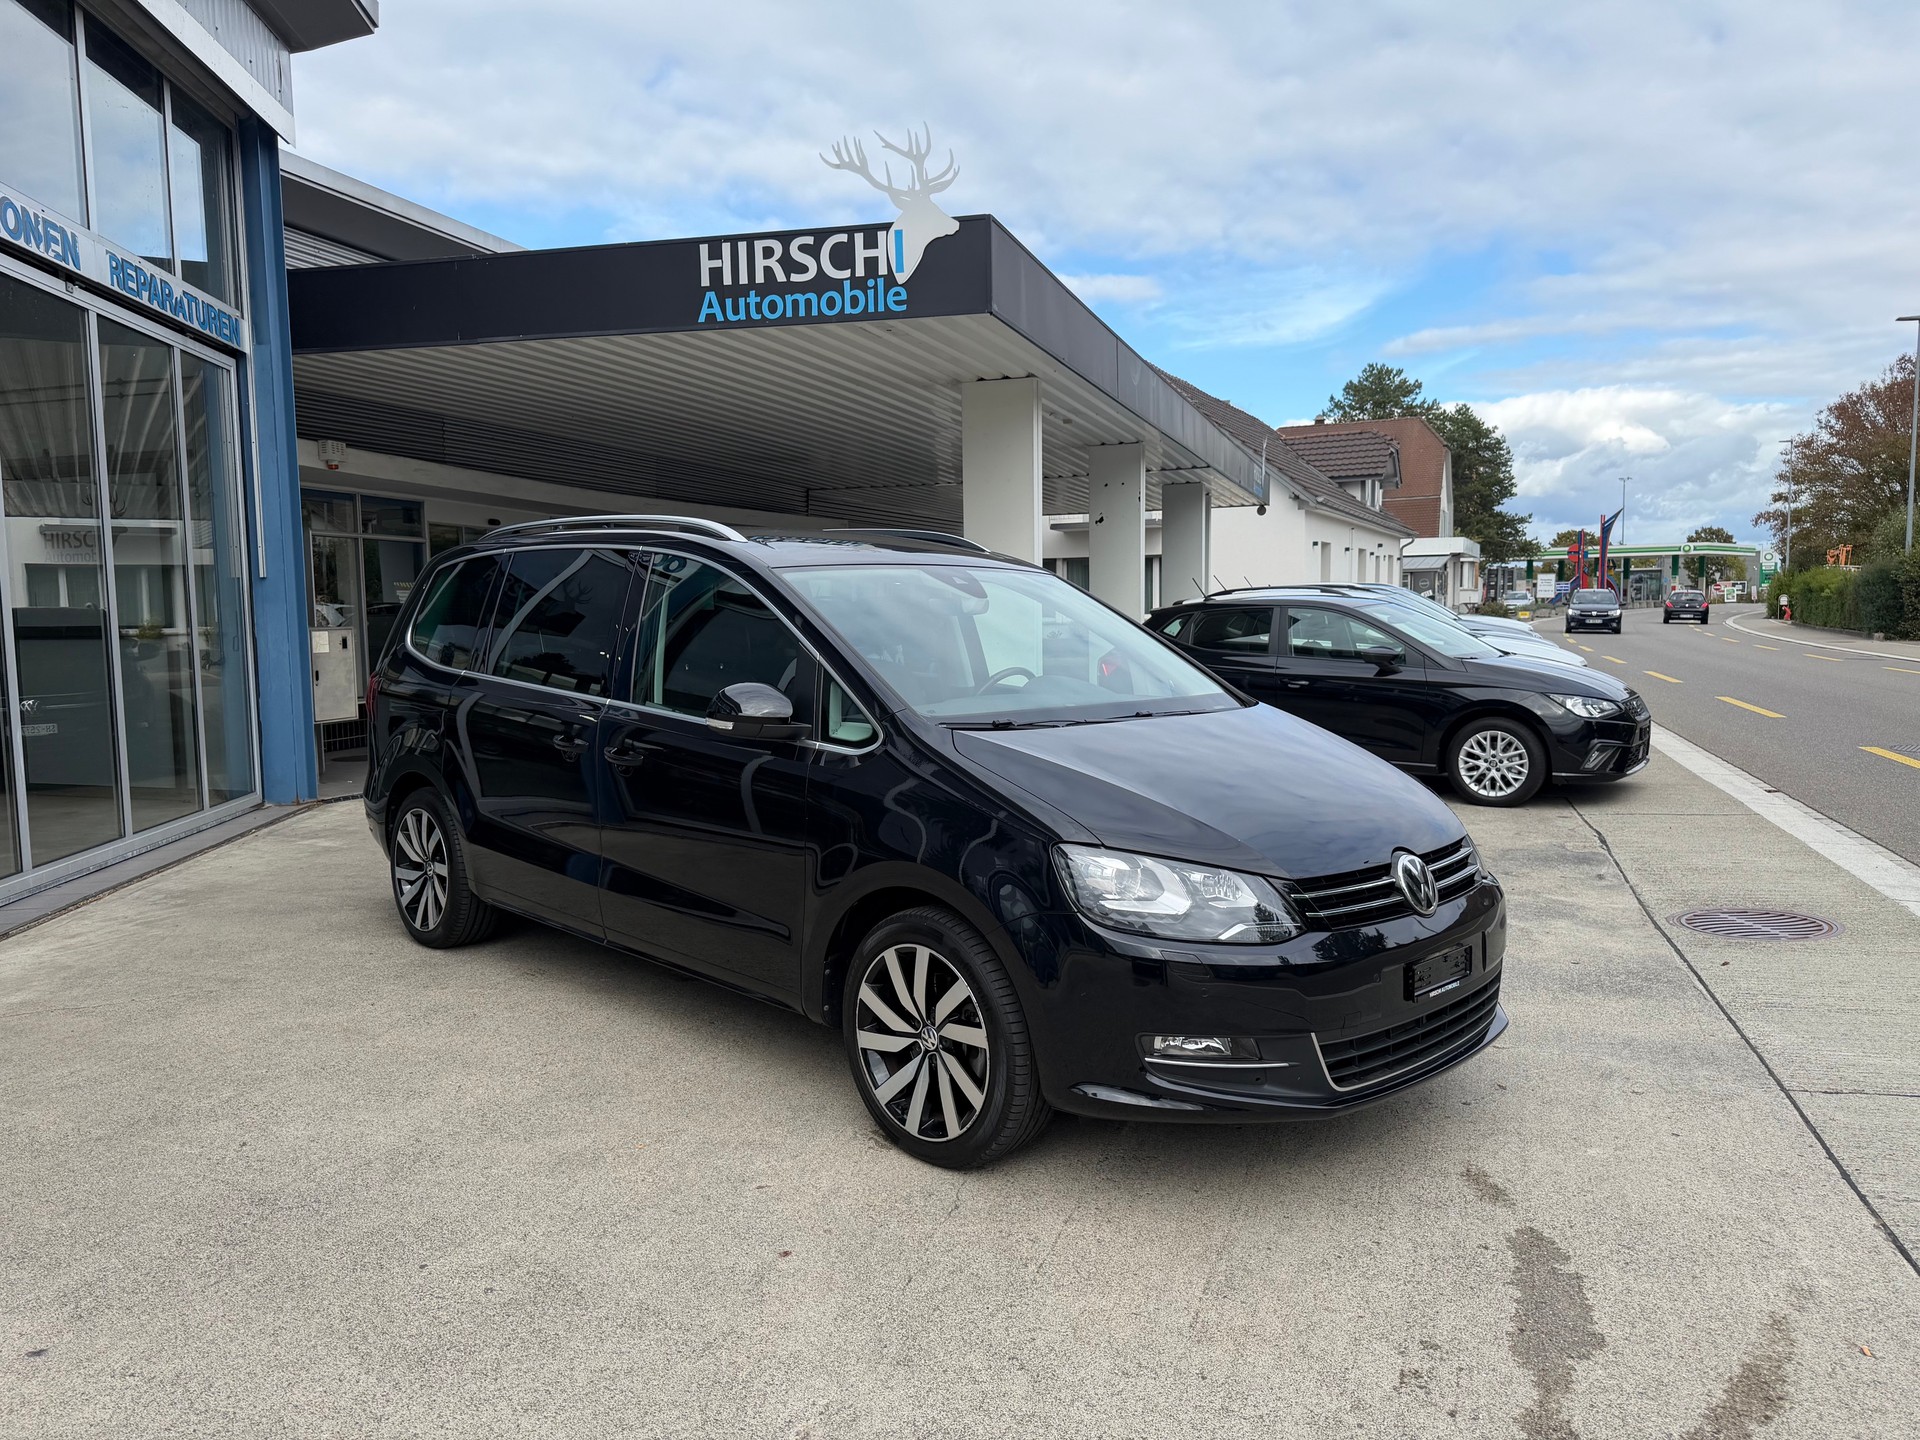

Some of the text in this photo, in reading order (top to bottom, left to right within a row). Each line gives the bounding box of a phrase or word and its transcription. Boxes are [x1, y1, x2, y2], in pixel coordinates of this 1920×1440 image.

[106, 249, 241, 348] REPARATUREN
[698, 277, 908, 323] Automobile
[43, 530, 97, 549] HIRSC
